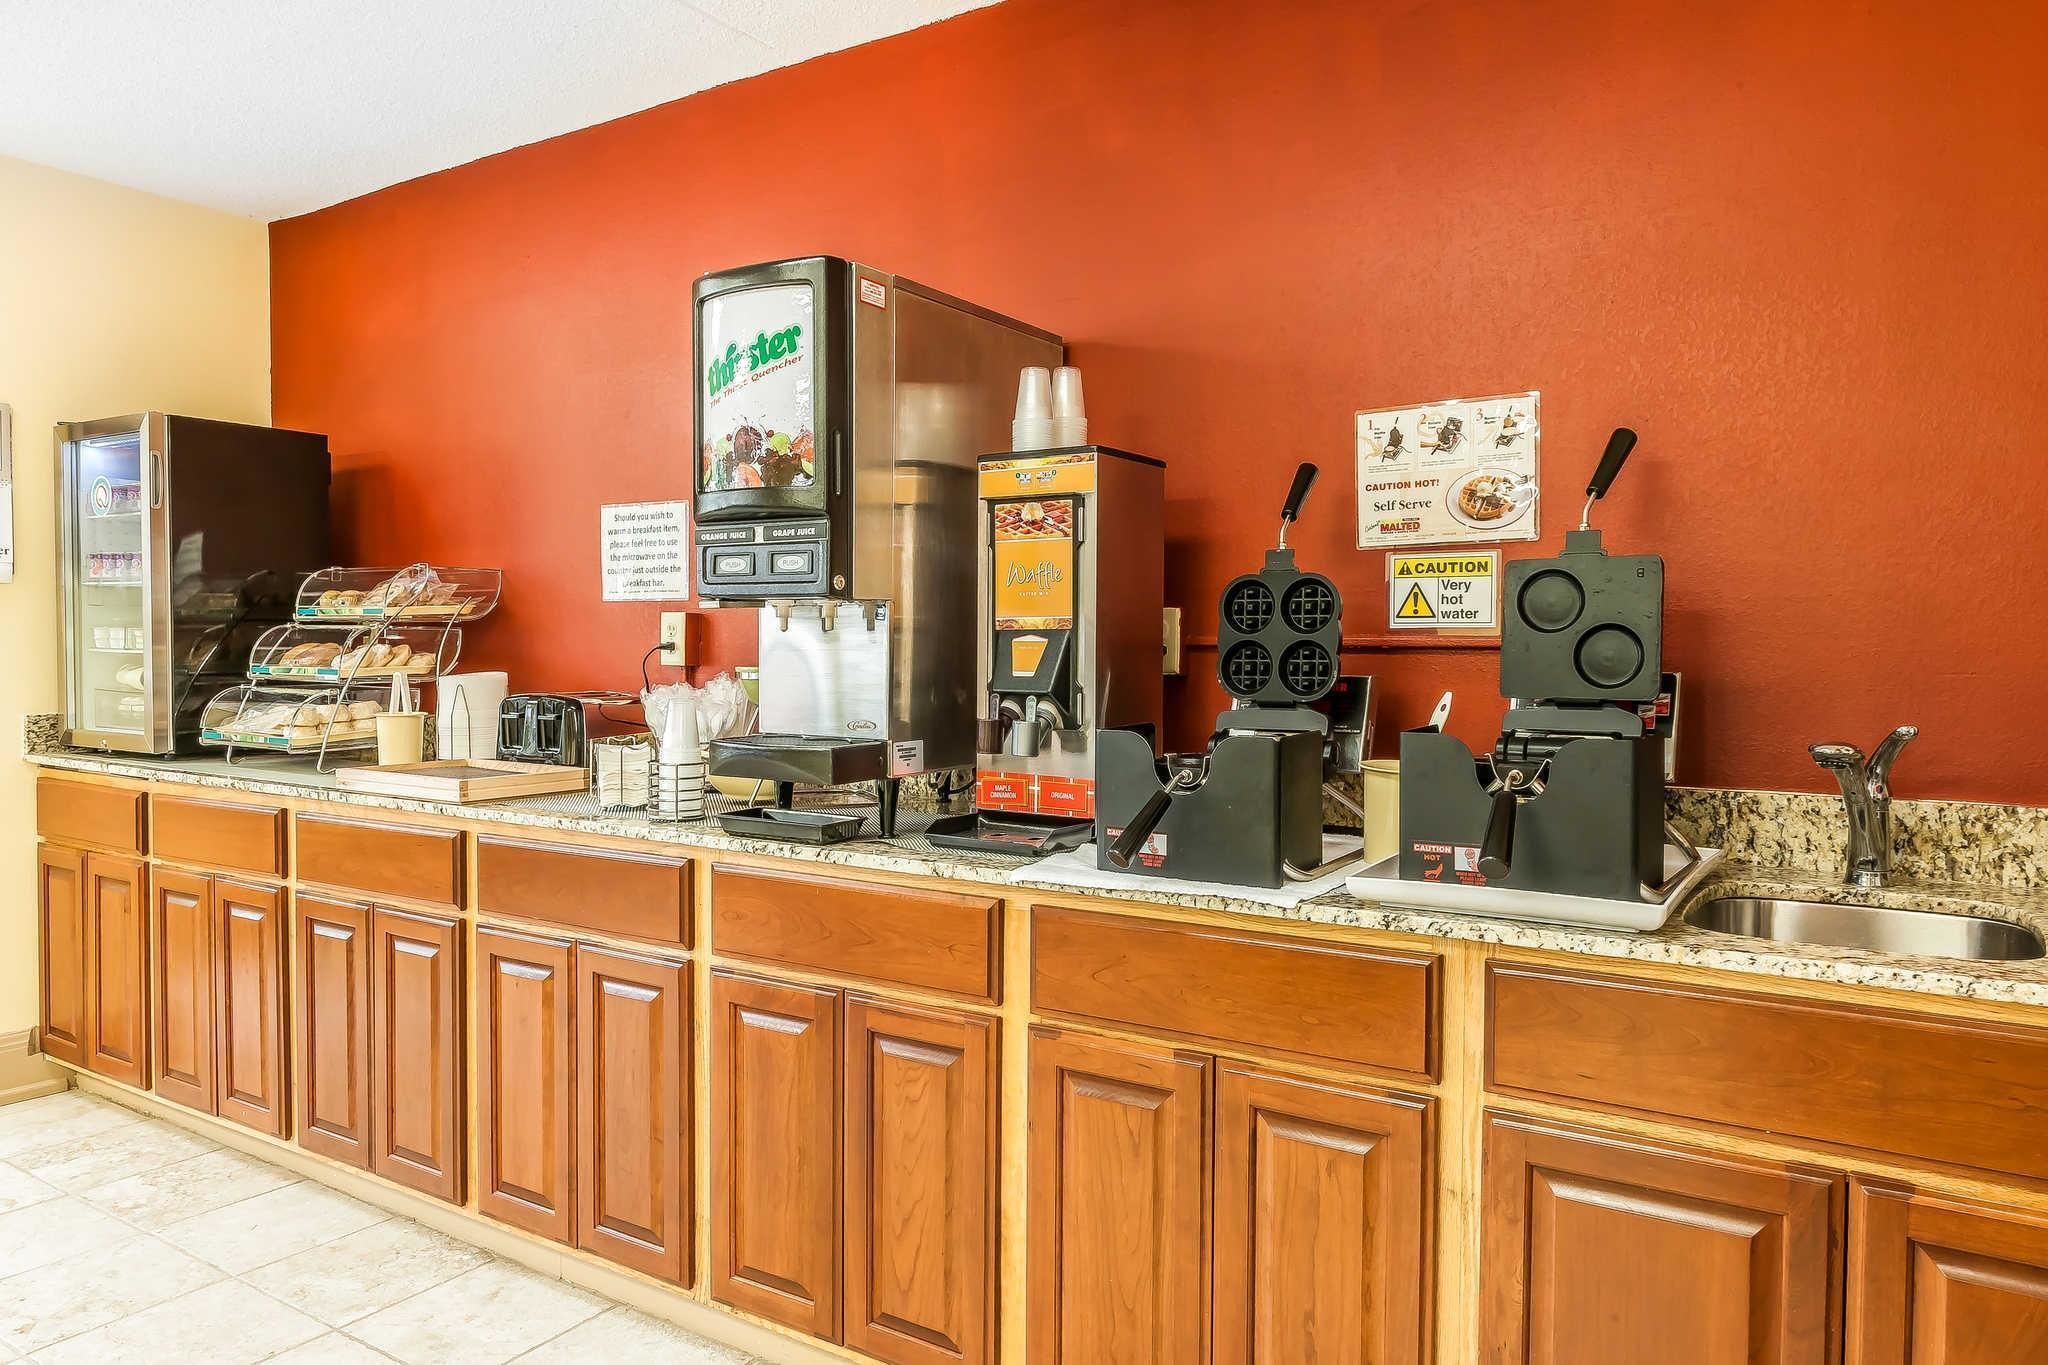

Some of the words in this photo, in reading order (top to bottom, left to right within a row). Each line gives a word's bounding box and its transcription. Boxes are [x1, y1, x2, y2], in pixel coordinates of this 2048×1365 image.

[751, 354, 804, 382] Quencher
[1476, 407, 1484, 421] 3
[1365, 481, 1411, 492] CAUTION
[1415, 479, 1440, 488] HOT!
[1373, 500, 1397, 512] Self
[1399, 499, 1432, 510] Serve
[614, 513, 636, 522] Should
[637, 513, 648, 522] you
[650, 511, 665, 520] wish
[666, 511, 674, 519] to
[632, 524, 662, 534] breakfast
[663, 524, 680, 533] item,
[772, 528, 796, 537] GRAPE
[796, 527, 816, 535] JUICE
[1380, 521, 1420, 532] MALTED
[701, 533, 728, 541] ORANGE
[728, 531, 747, 539] JUICE
[609, 540, 631, 550] please
[631, 539, 643, 548] feel
[644, 538, 657, 547] free
[667, 538, 678, 546] use
[610, 553, 621, 562] the
[622, 552, 656, 561] microwave
[667, 551, 679, 559] the
[632, 566, 644, 576] just
[645, 564, 669, 574] outside
[670, 564, 681, 573] the
[1414, 561, 1489, 574] CAUTION
[1006, 560, 1063, 589] Waffle
[1441, 579, 1472, 593] Very
[1441, 593, 1464, 605] hot
[1440, 608, 1479, 619] water
[994, 784, 1012, 792] MAPLE
[1051, 792, 1075, 800] ORIGINAL
[1413, 843, 1452, 853] CAUTION
[1424, 853, 1441, 861] HOT
